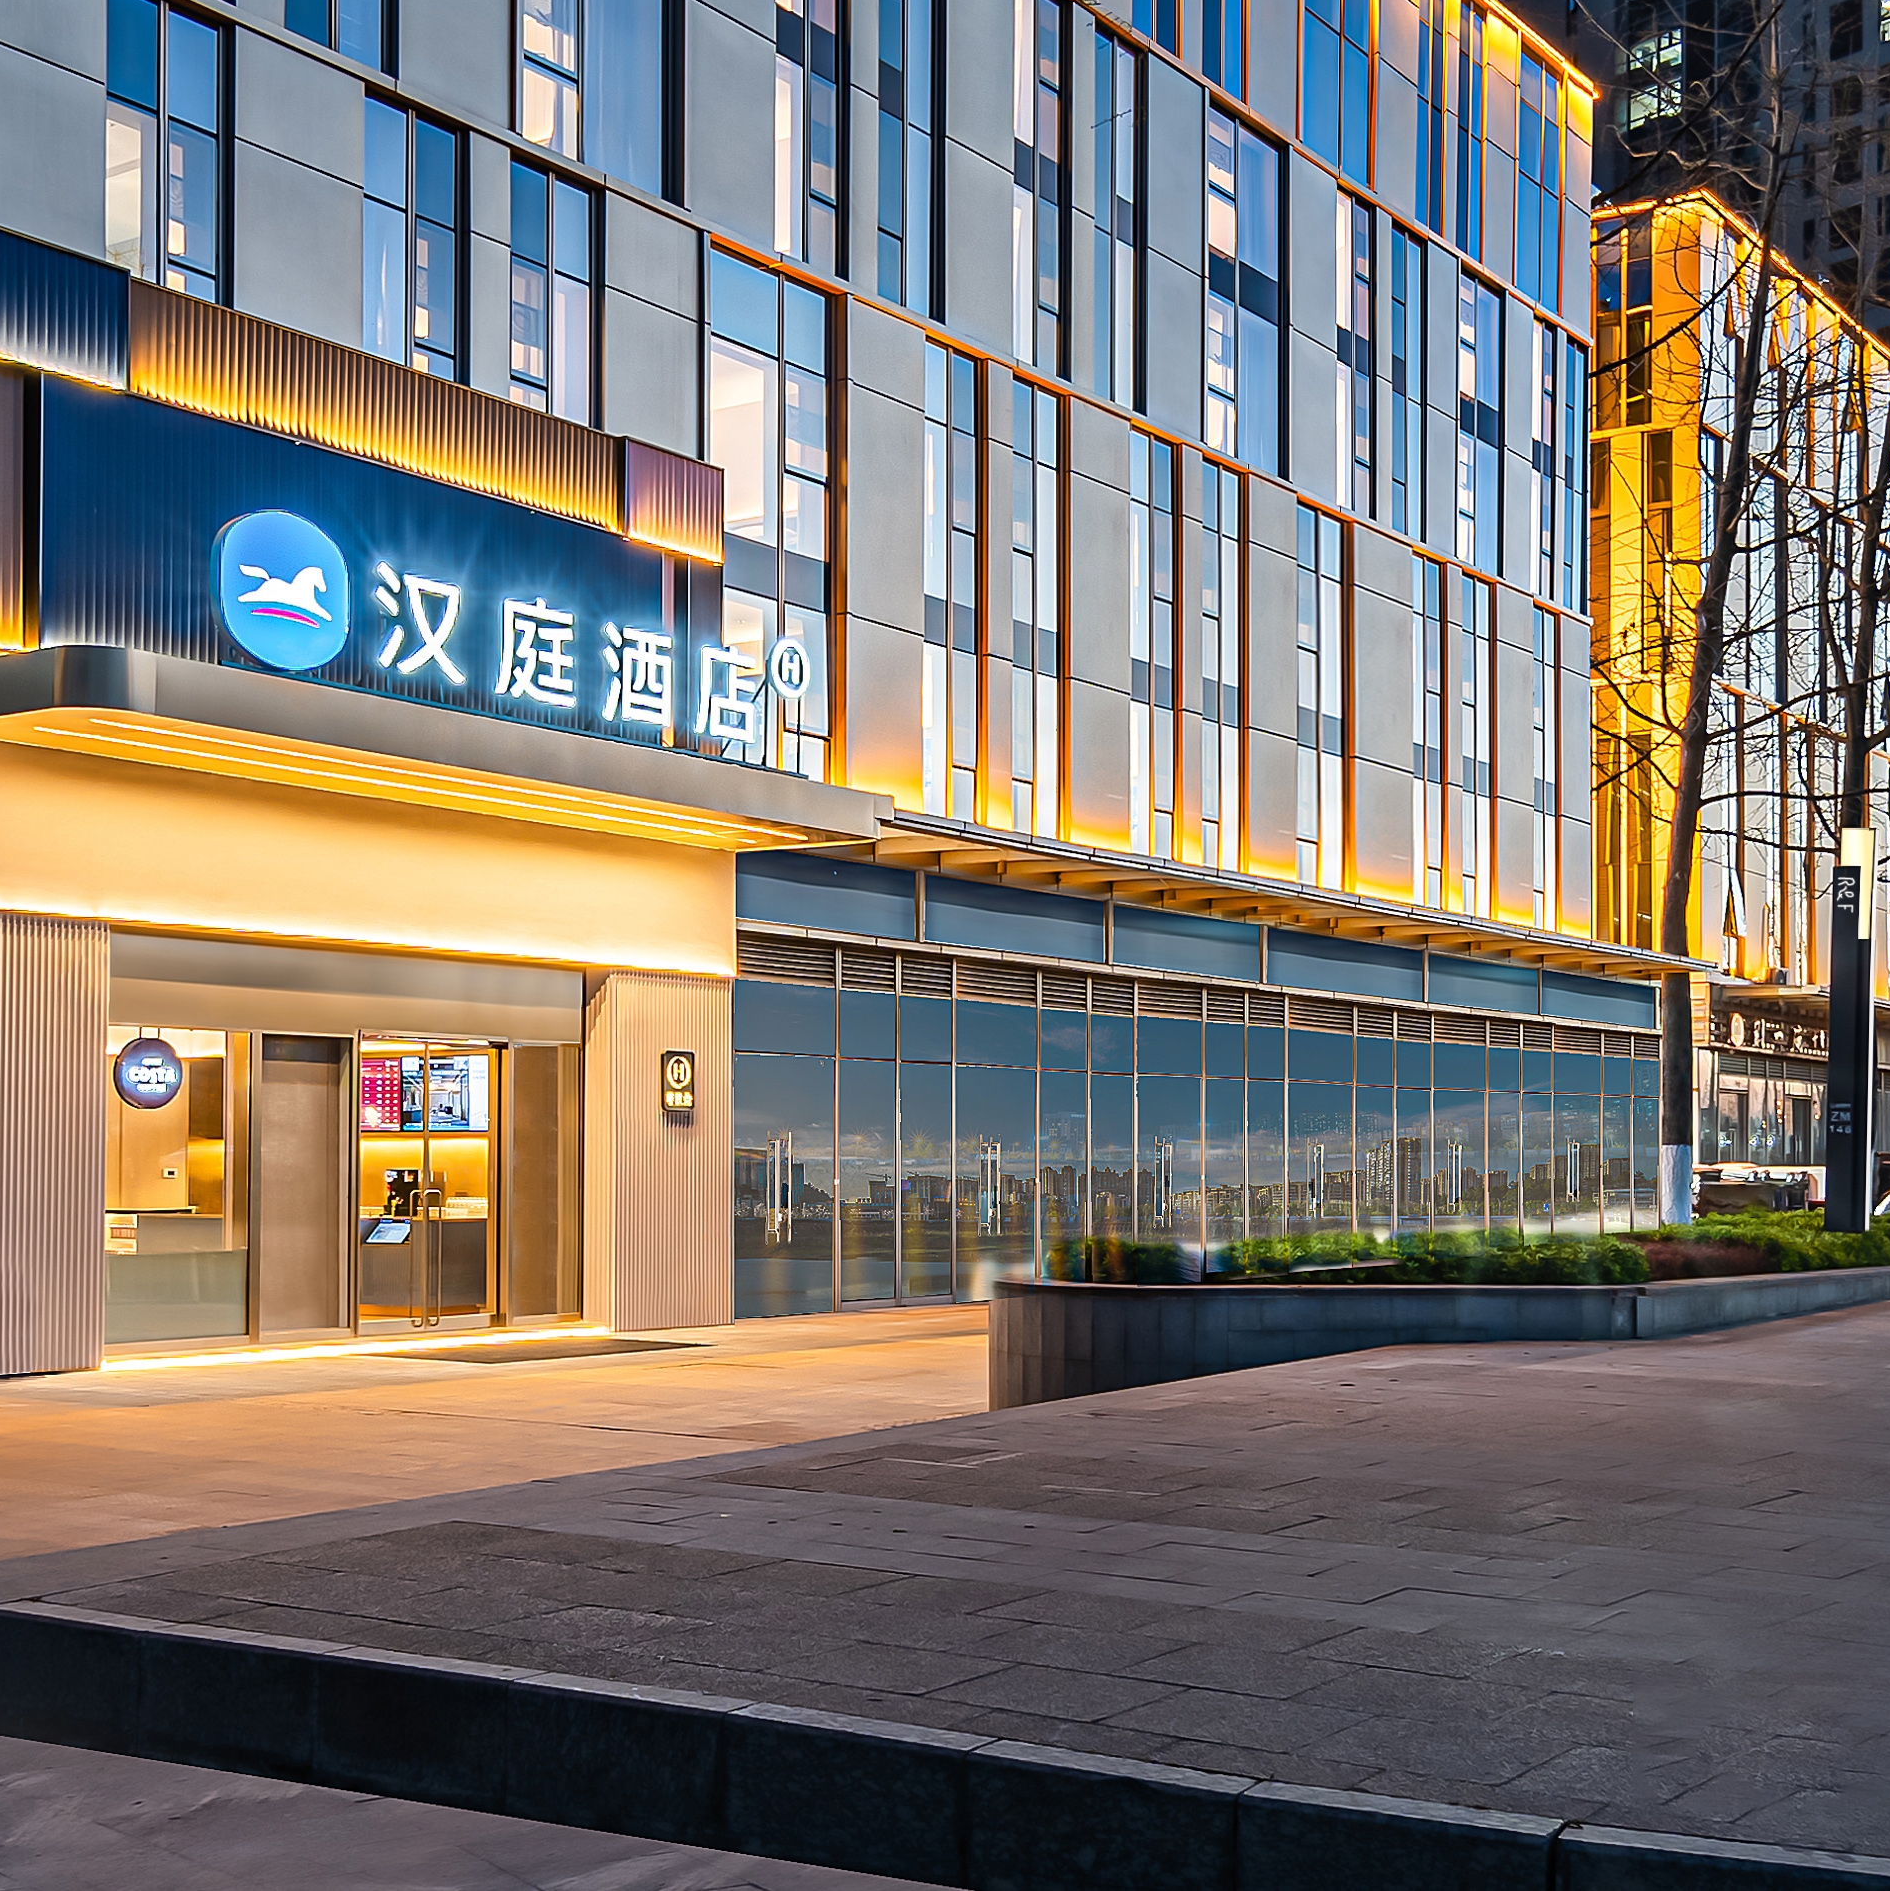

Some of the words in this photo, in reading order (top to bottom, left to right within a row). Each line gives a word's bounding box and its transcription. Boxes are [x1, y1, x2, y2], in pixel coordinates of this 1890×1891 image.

[374, 559, 758, 743] 汉庭酒店
[1837, 876, 1856, 914] R&F
[1830, 1111, 1851, 1122] ZM
